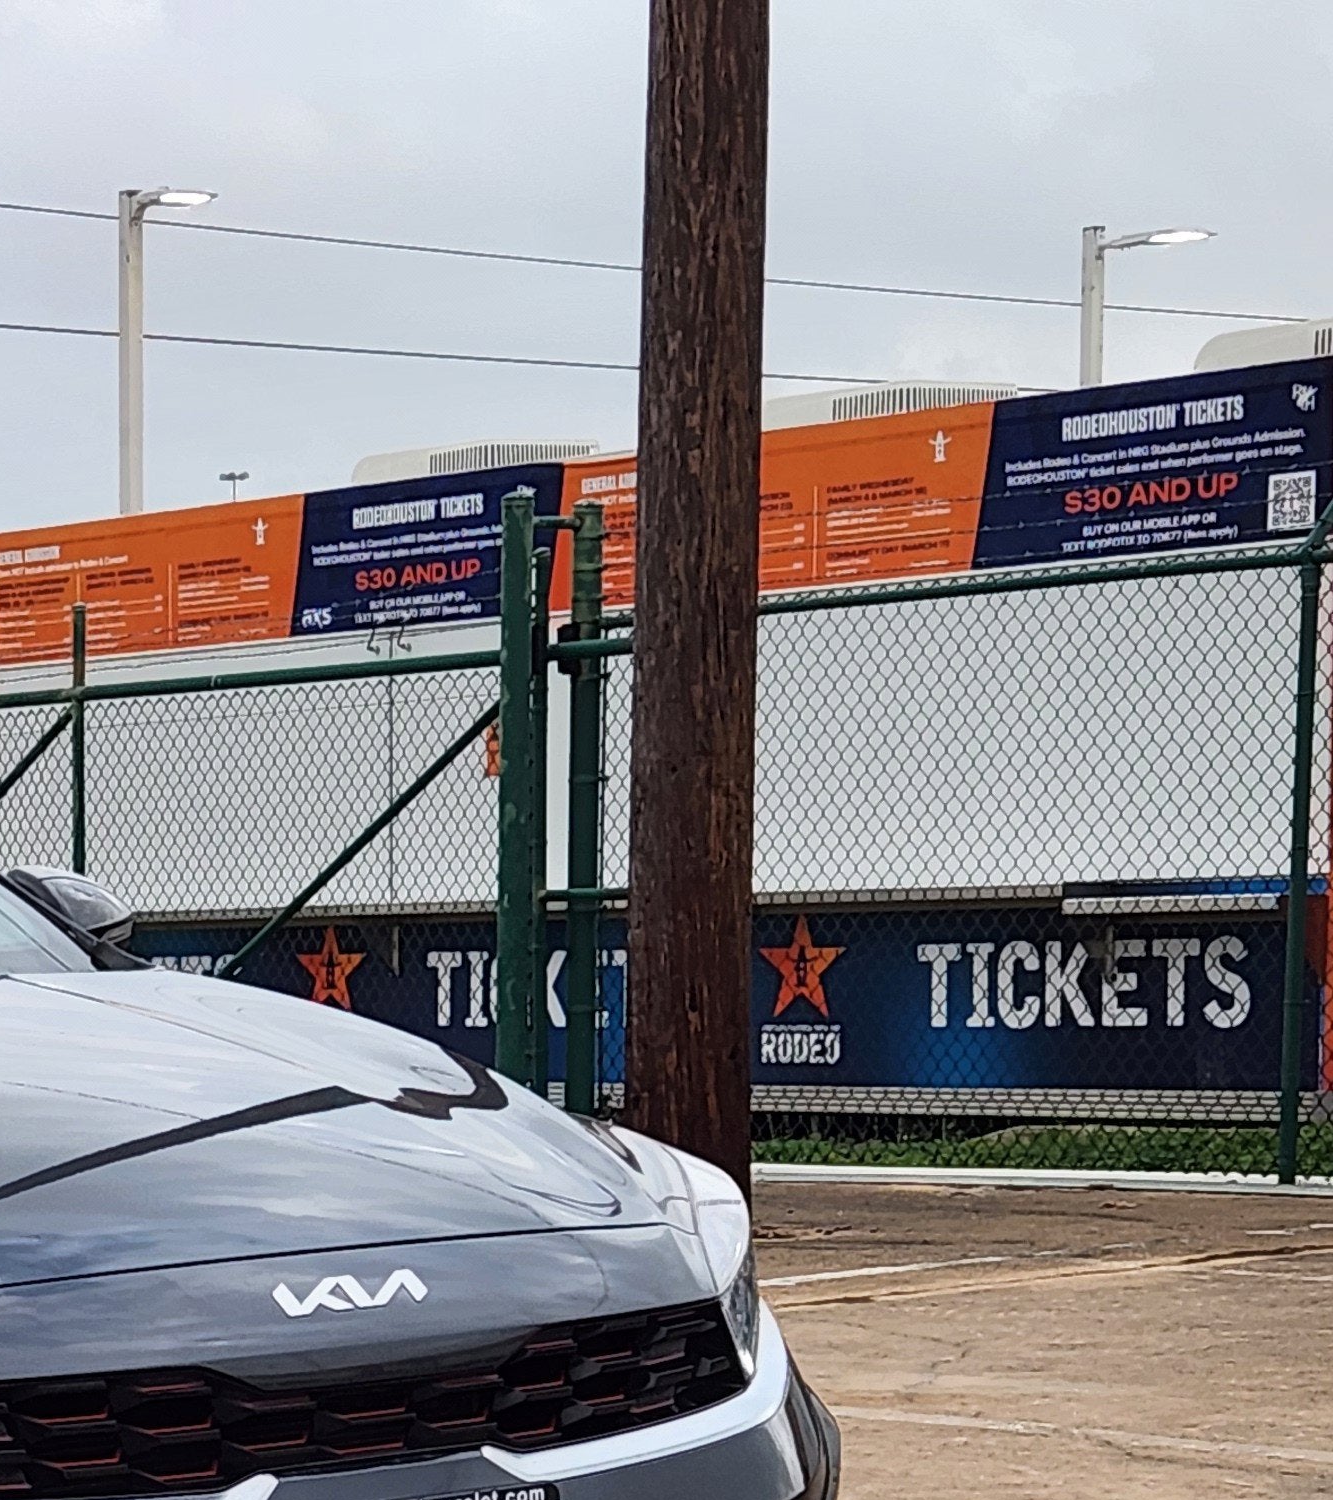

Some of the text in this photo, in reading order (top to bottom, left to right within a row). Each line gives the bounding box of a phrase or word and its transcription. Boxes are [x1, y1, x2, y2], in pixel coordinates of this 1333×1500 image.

[1061, 395, 1244, 442] RODEOHOUSTON TICKETS
[1081, 449, 1118, 464] Concert
[1128, 445, 1149, 458] NRG
[1190, 439, 1210, 453] plus
[1211, 433, 1252, 449] Grounds
[1187, 451, 1233, 468] performer
[440, 493, 484, 519] TICKETS
[1127, 476, 1191, 508] AND
[1197, 472, 1238, 499] UP
[400, 560, 448, 587] AND
[451, 557, 482, 581] UP
[917, 934, 1252, 1030] TICKETS
[760, 1031, 842, 1065] RODEO
[272, 1268, 429, 1319] KIA
